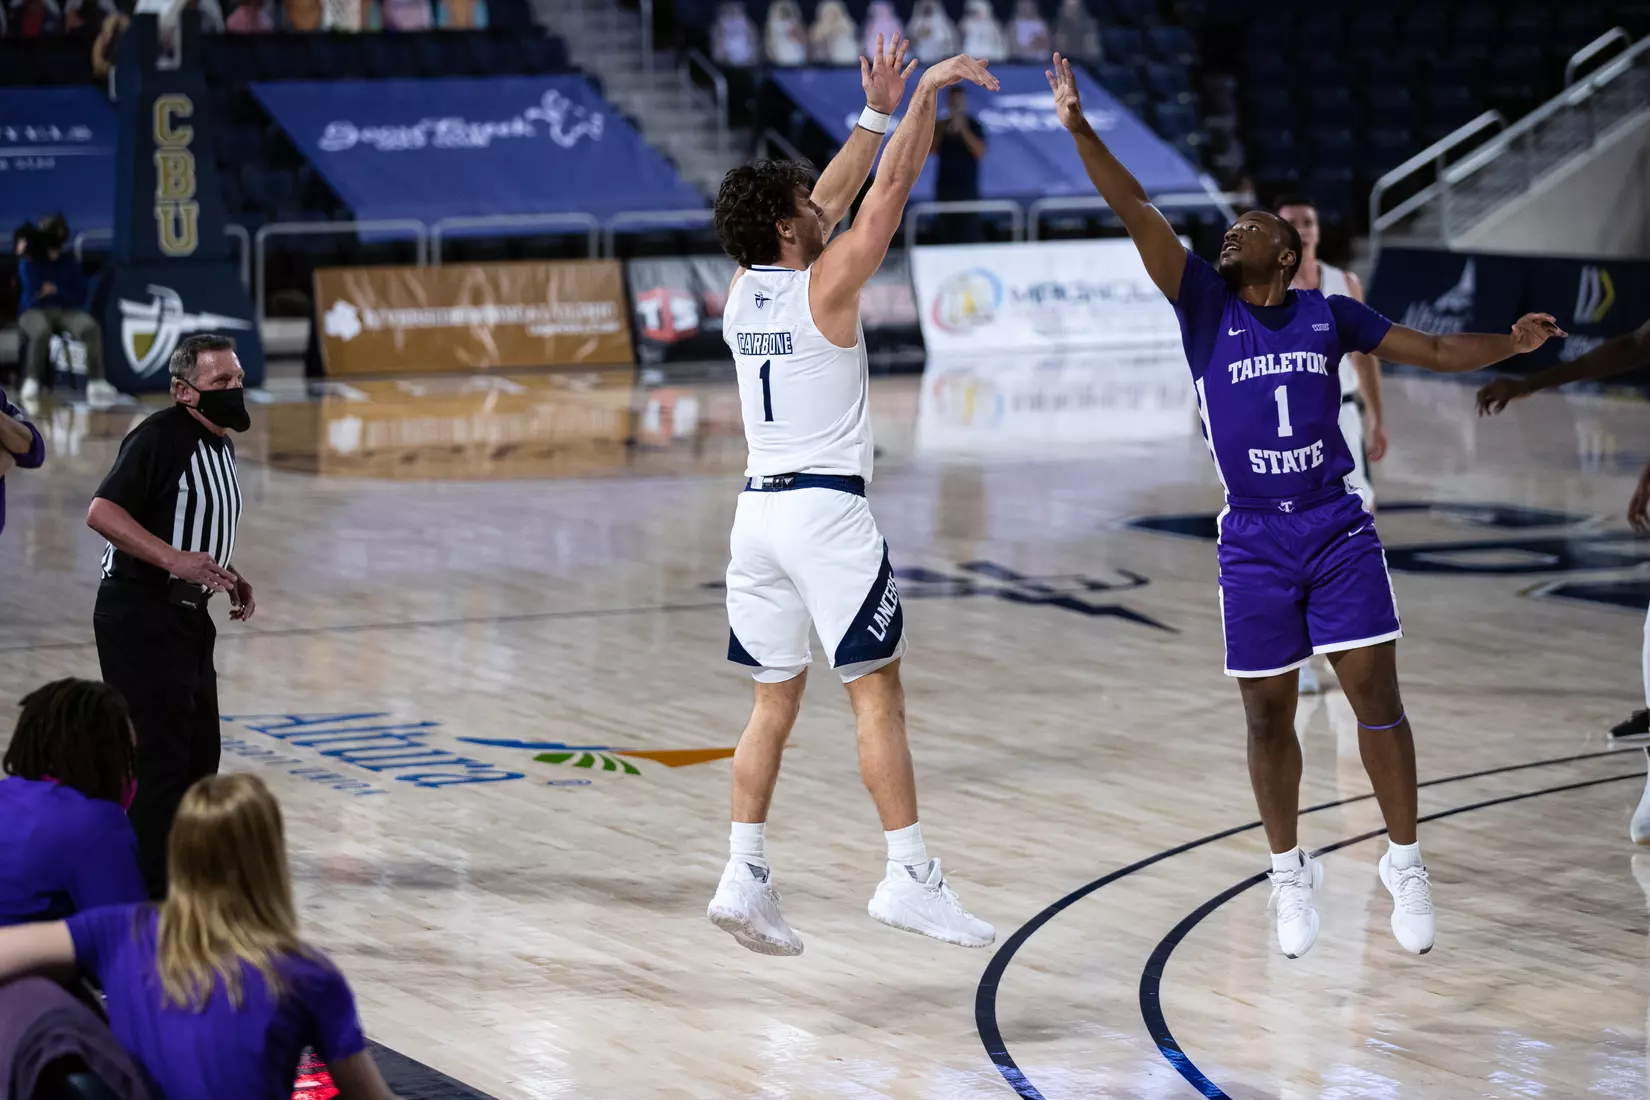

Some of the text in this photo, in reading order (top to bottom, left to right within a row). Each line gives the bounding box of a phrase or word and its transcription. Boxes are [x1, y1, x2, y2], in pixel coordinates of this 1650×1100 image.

[153, 93, 199, 257] CBU
[737, 332, 793, 355] CARBONE
[1229, 352, 1328, 384] TARLETON
[759, 359, 774, 422] 1
[1274, 385, 1293, 437] 1
[1248, 439, 1324, 474] STATE
